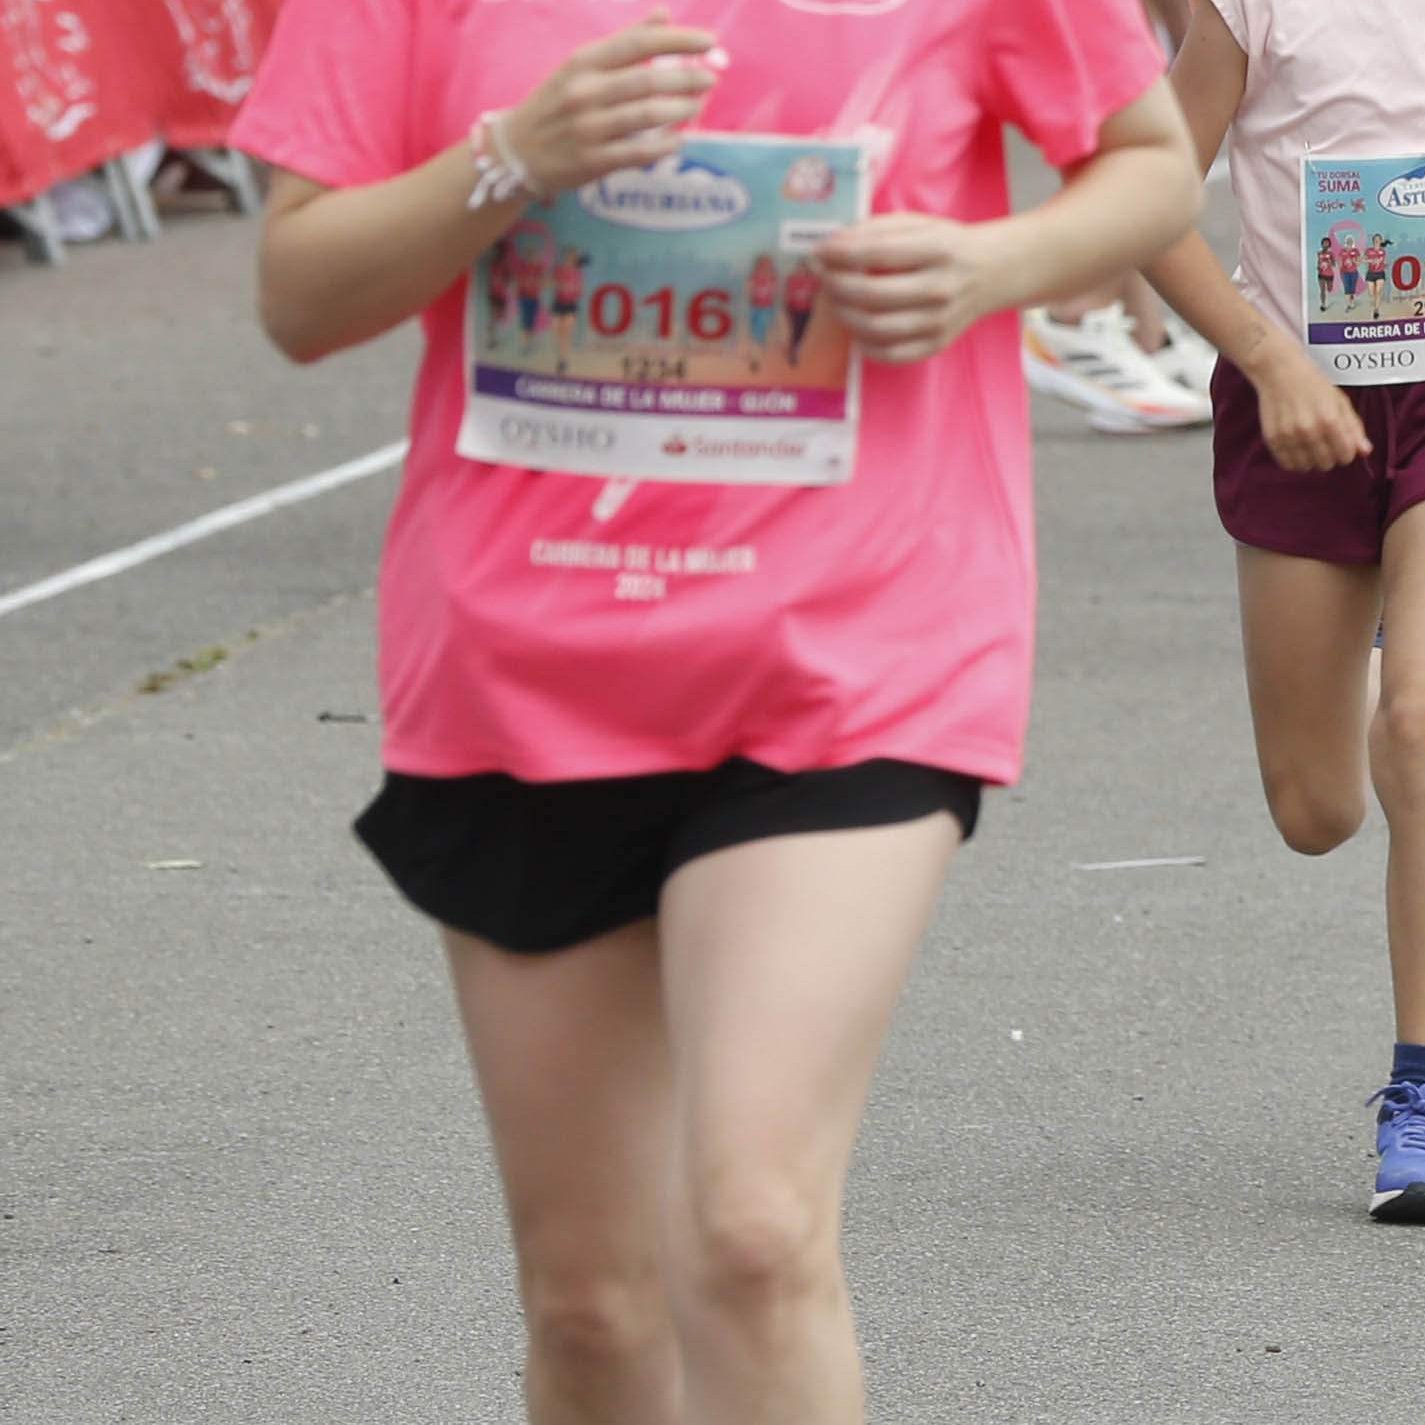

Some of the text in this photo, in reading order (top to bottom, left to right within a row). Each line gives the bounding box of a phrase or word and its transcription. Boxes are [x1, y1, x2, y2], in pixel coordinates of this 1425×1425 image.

[1318, 180, 1360, 192] SUMA
[588, 283, 734, 340] 016
[1343, 325, 1402, 340] CARRERA
[1404, 322, 1420, 335] DE
[1334, 349, 1415, 371] OYSHO
[600, 386, 627, 408] DE
